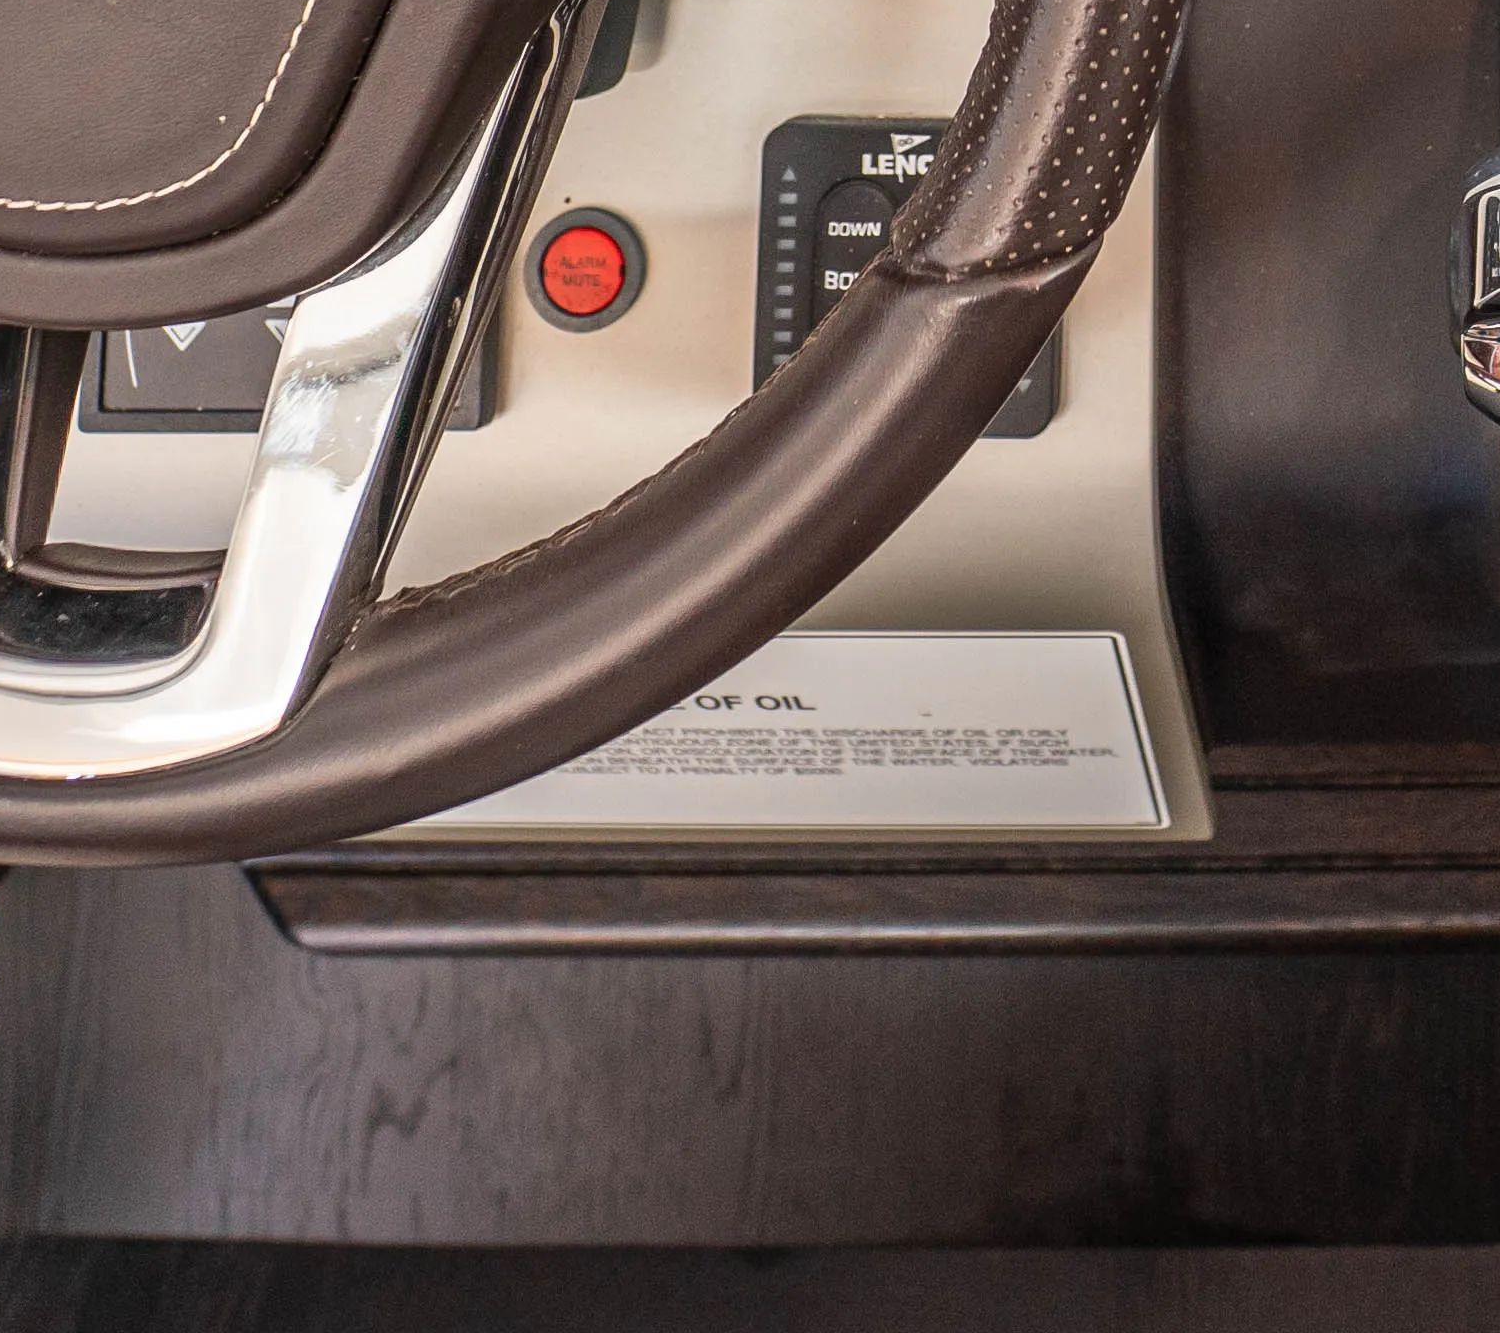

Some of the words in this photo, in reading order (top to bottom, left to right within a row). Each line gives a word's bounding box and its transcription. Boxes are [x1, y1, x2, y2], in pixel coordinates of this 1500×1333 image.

[862, 153, 934, 175] LENC
[828, 222, 881, 236] DOWN
[560, 256, 606, 269] ALARM
[563, 274, 601, 286] MUTE
[824, 271, 859, 290] BO
[694, 695, 742, 711] OF
[755, 695, 817, 711] OIL
